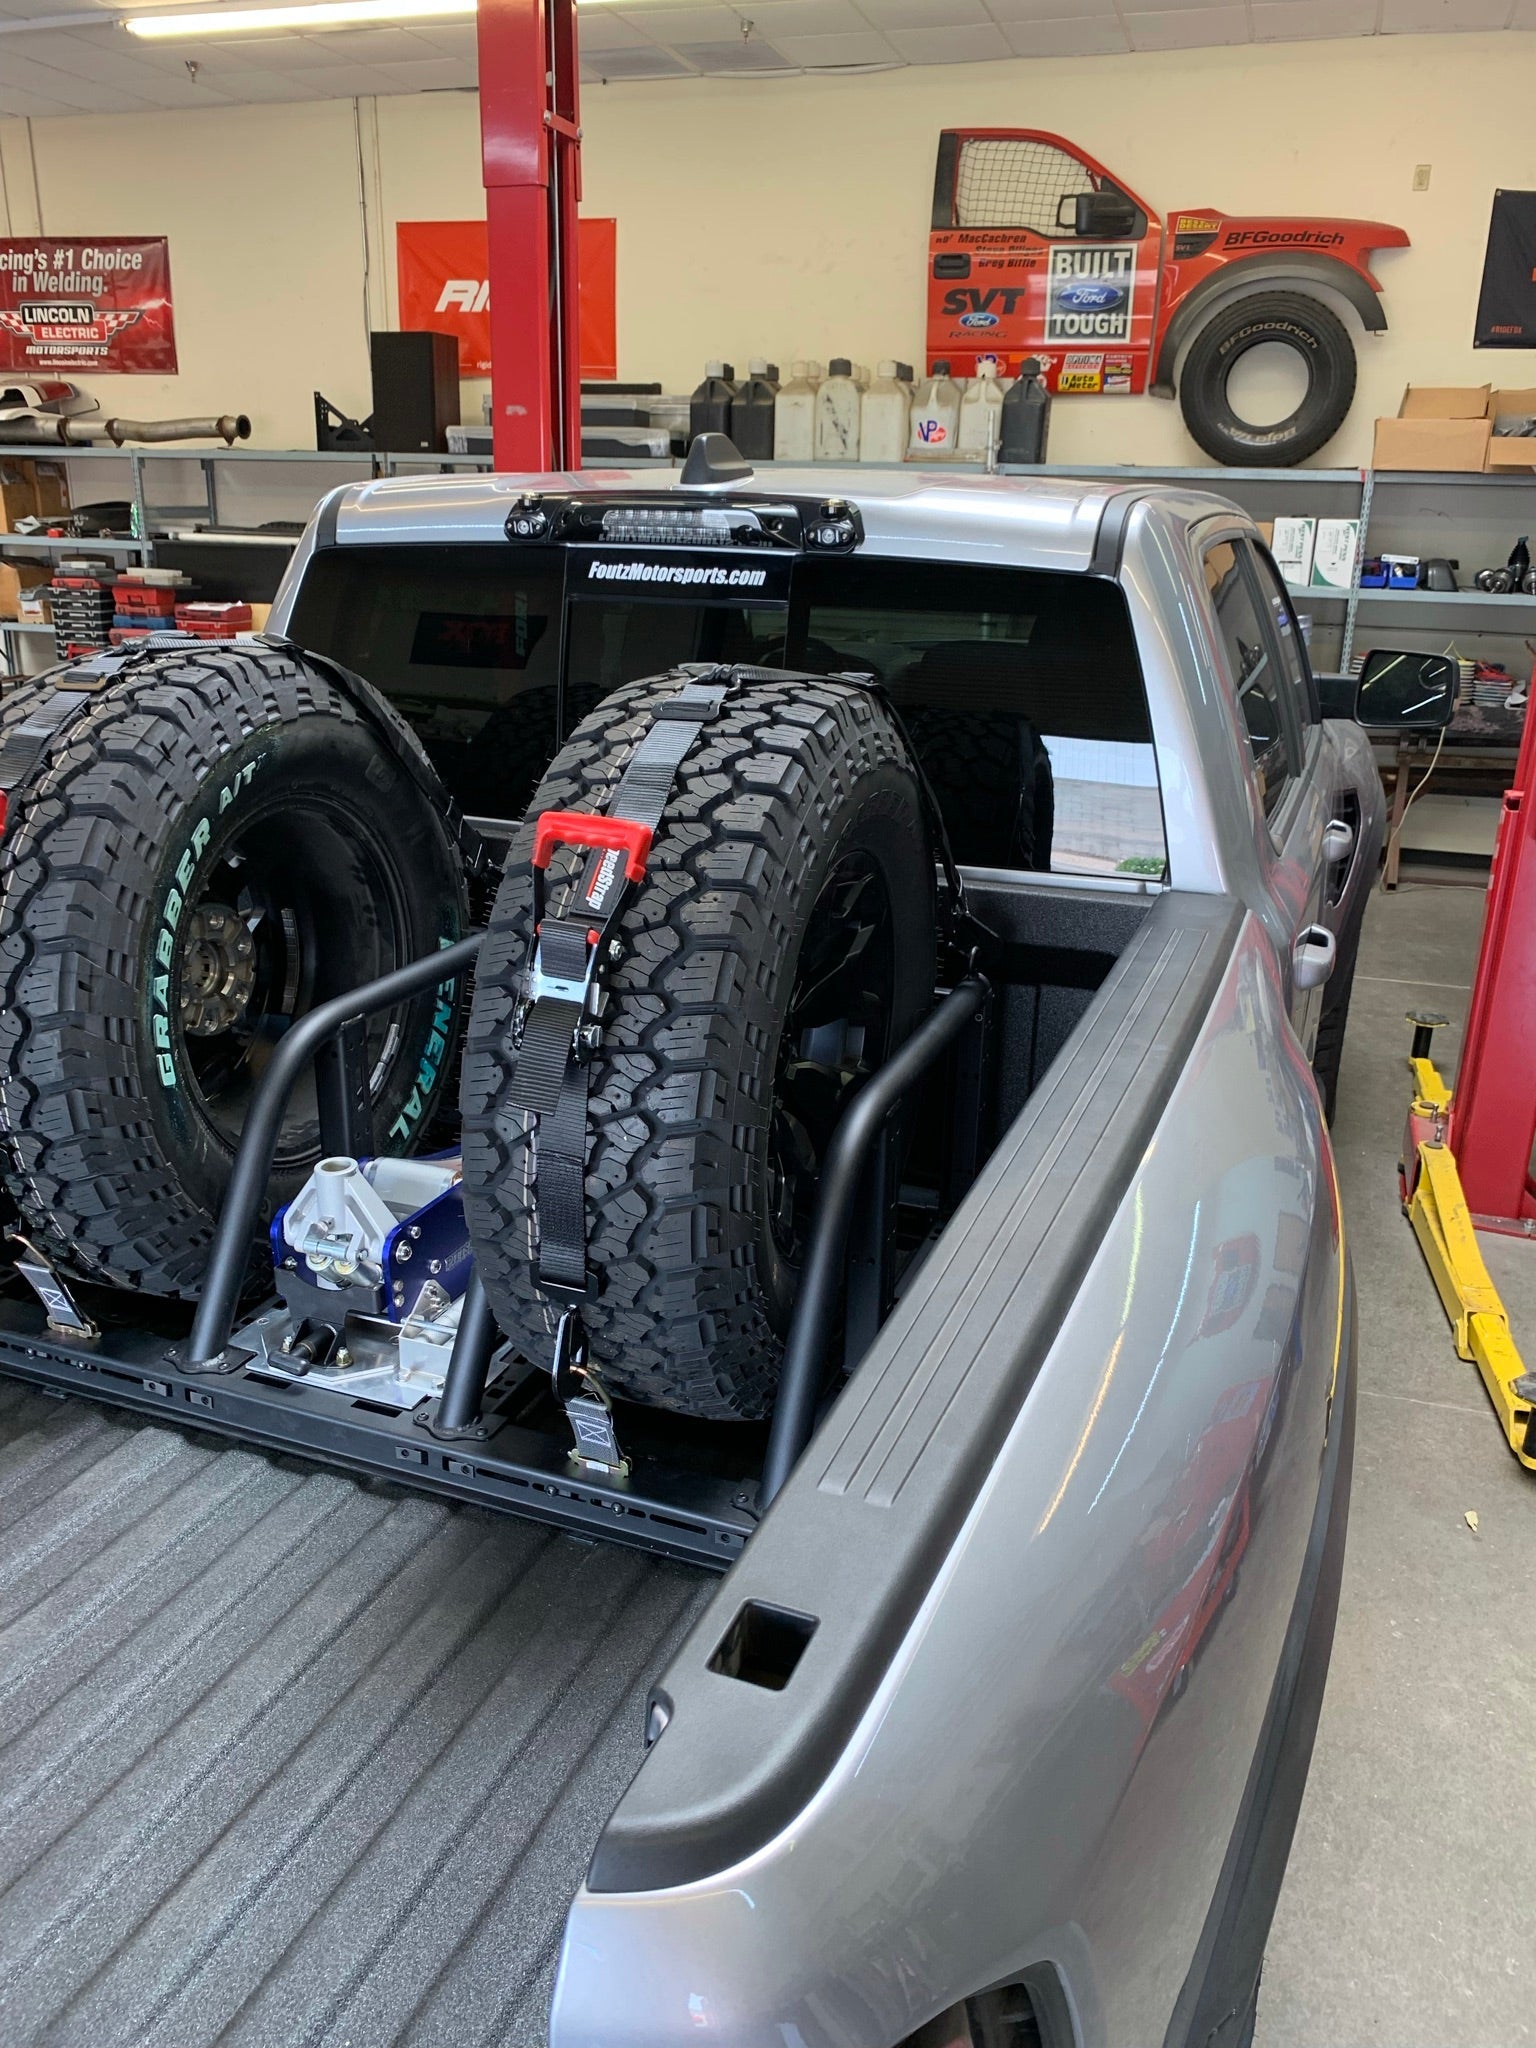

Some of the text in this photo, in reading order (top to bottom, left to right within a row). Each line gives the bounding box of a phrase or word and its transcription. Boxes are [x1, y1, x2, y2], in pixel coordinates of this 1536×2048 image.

[1225, 231, 1345, 245] BFGoodrich
[53, 248, 75, 270] #1
[81, 247, 143, 271] Choice
[1056, 251, 1131, 280] BUILT
[12, 271, 108, 297] in Welding.
[1072, 287, 1108, 304] Ford
[434, 279, 490, 313] RI
[941, 286, 1026, 316] SVT
[24, 307, 90, 324] LINCOLN
[965, 313, 992, 327] Ford
[1052, 312, 1124, 335] TOUGH
[41, 326, 99, 339] ELECTRIC
[948, 330, 1009, 339] RACING
[1219, 321, 1319, 355] BFGoodrich
[26, 345, 109, 356] MOTORSPORTS
[1068, 382, 1098, 390] Meter
[1071, 374, 1095, 382] Auto
[918, 420, 938, 443] VP
[588, 562, 766, 587] FoutzMotorsports.com
[585, 848, 621, 911] eedStrap
[153, 817, 211, 1087] GRABBER
